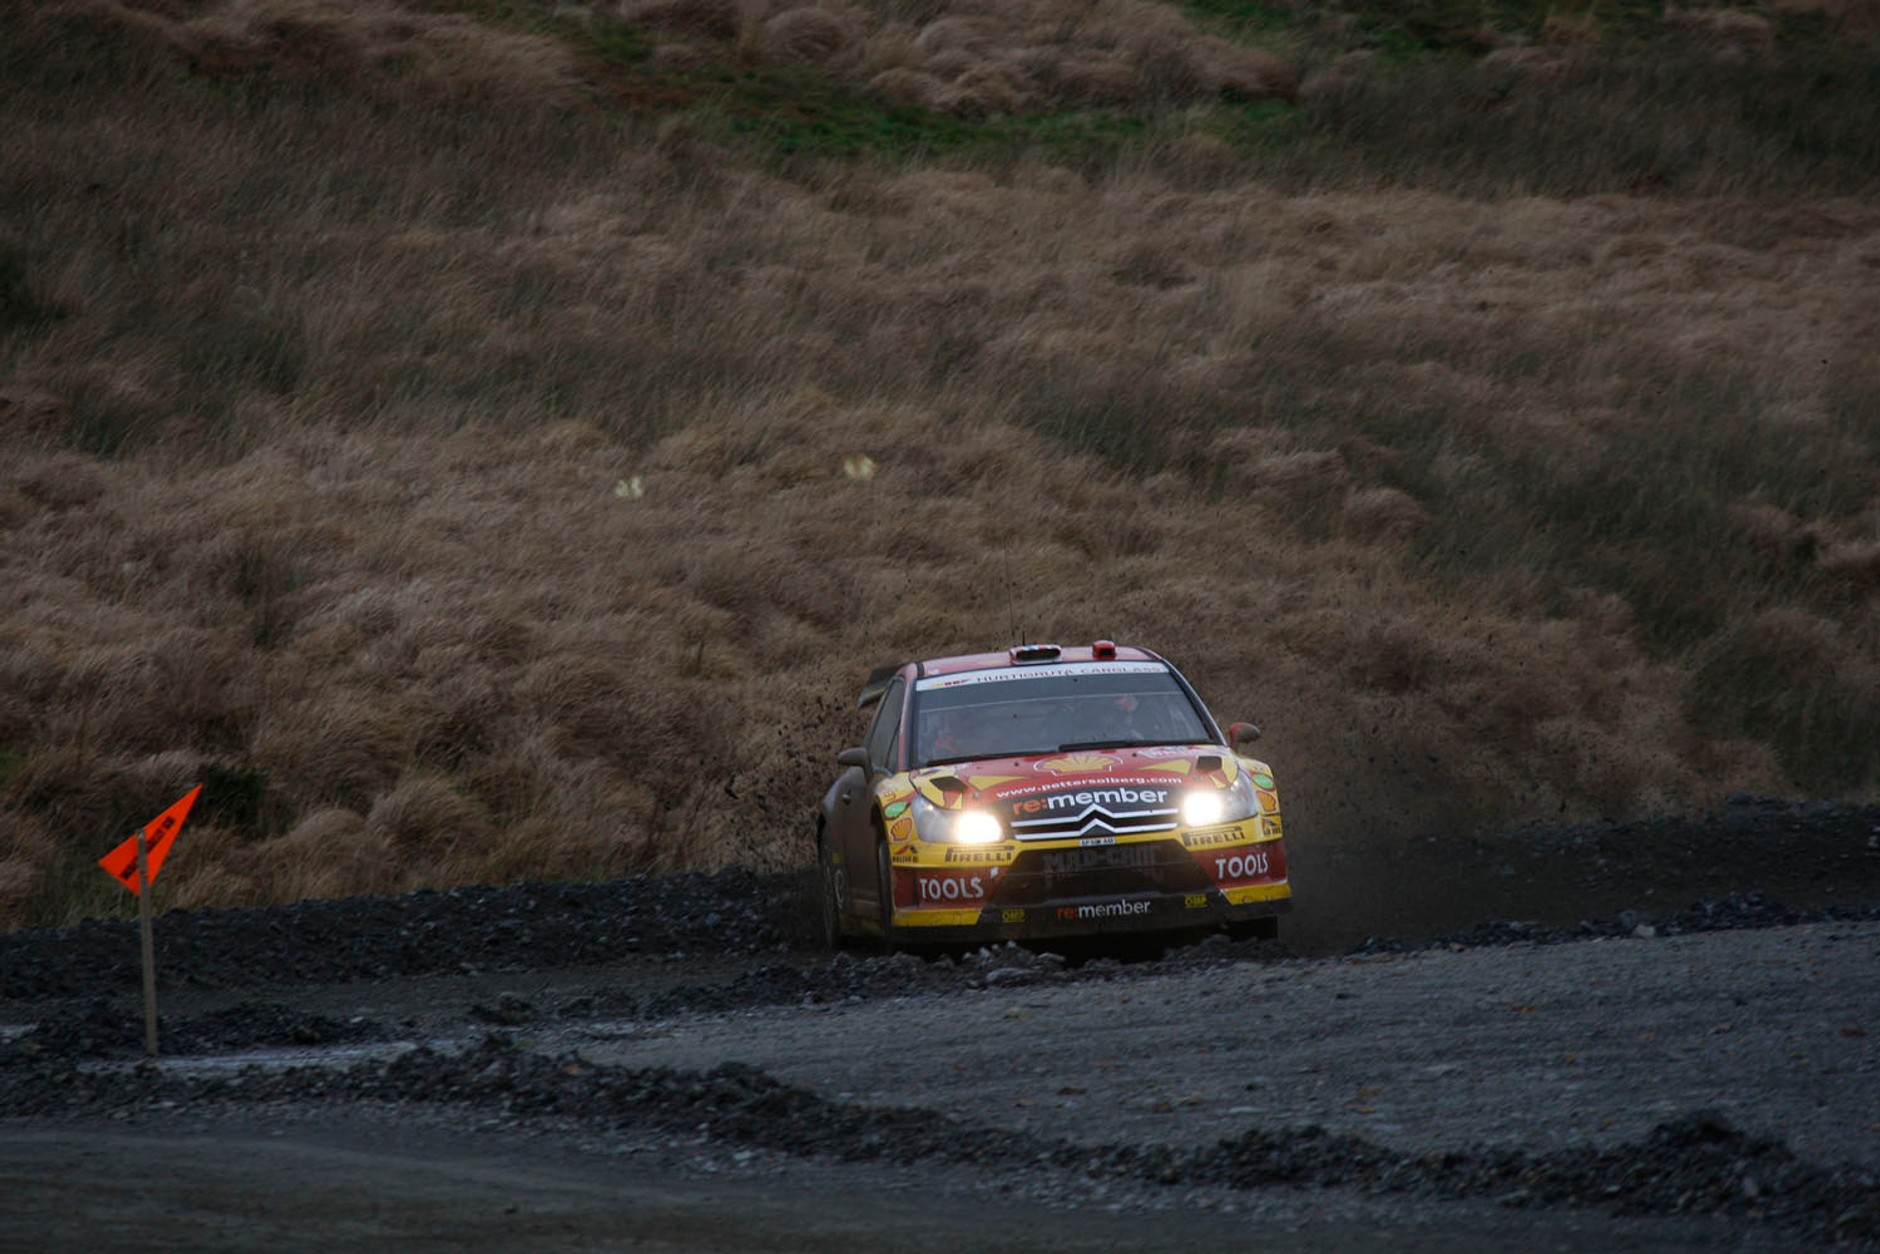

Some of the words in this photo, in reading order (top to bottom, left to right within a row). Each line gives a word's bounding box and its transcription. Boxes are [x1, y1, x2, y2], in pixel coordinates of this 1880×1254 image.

[996, 776, 1182, 799] www.pettersolberg.com
[1012, 787, 1168, 816] re:member
[1181, 825, 1246, 847] PIRELLI
[945, 845, 1016, 862] PIRELLI
[1215, 852, 1269, 880] TOOLS
[919, 876, 984, 900] TOOLS
[1056, 899, 1151, 919] re:member
